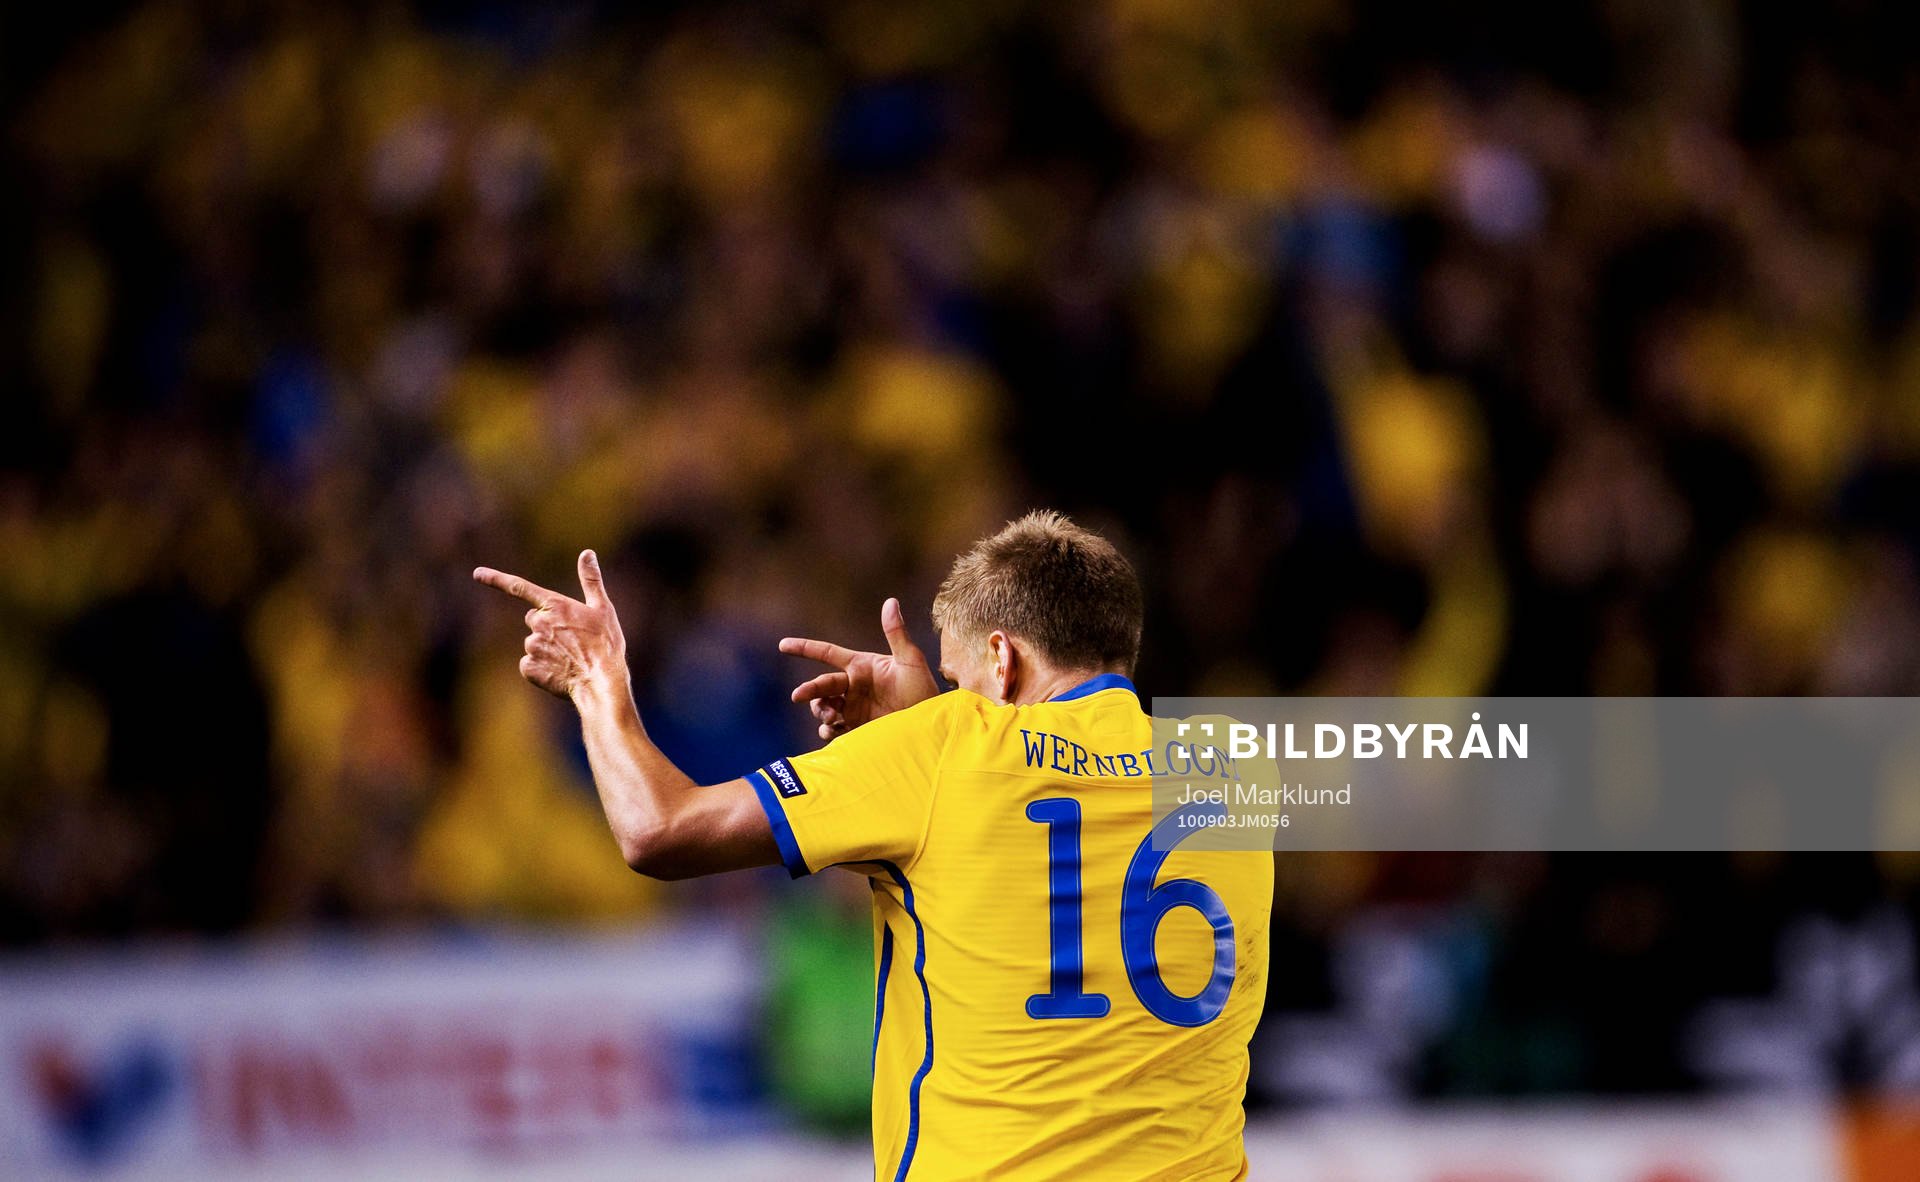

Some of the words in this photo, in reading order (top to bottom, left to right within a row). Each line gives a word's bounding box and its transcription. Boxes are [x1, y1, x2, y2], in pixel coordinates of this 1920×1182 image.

[770, 760, 800, 794] RESPECT
[1020, 729, 1241, 781] WERNBLOOM
[1025, 797, 1236, 1028] 16
